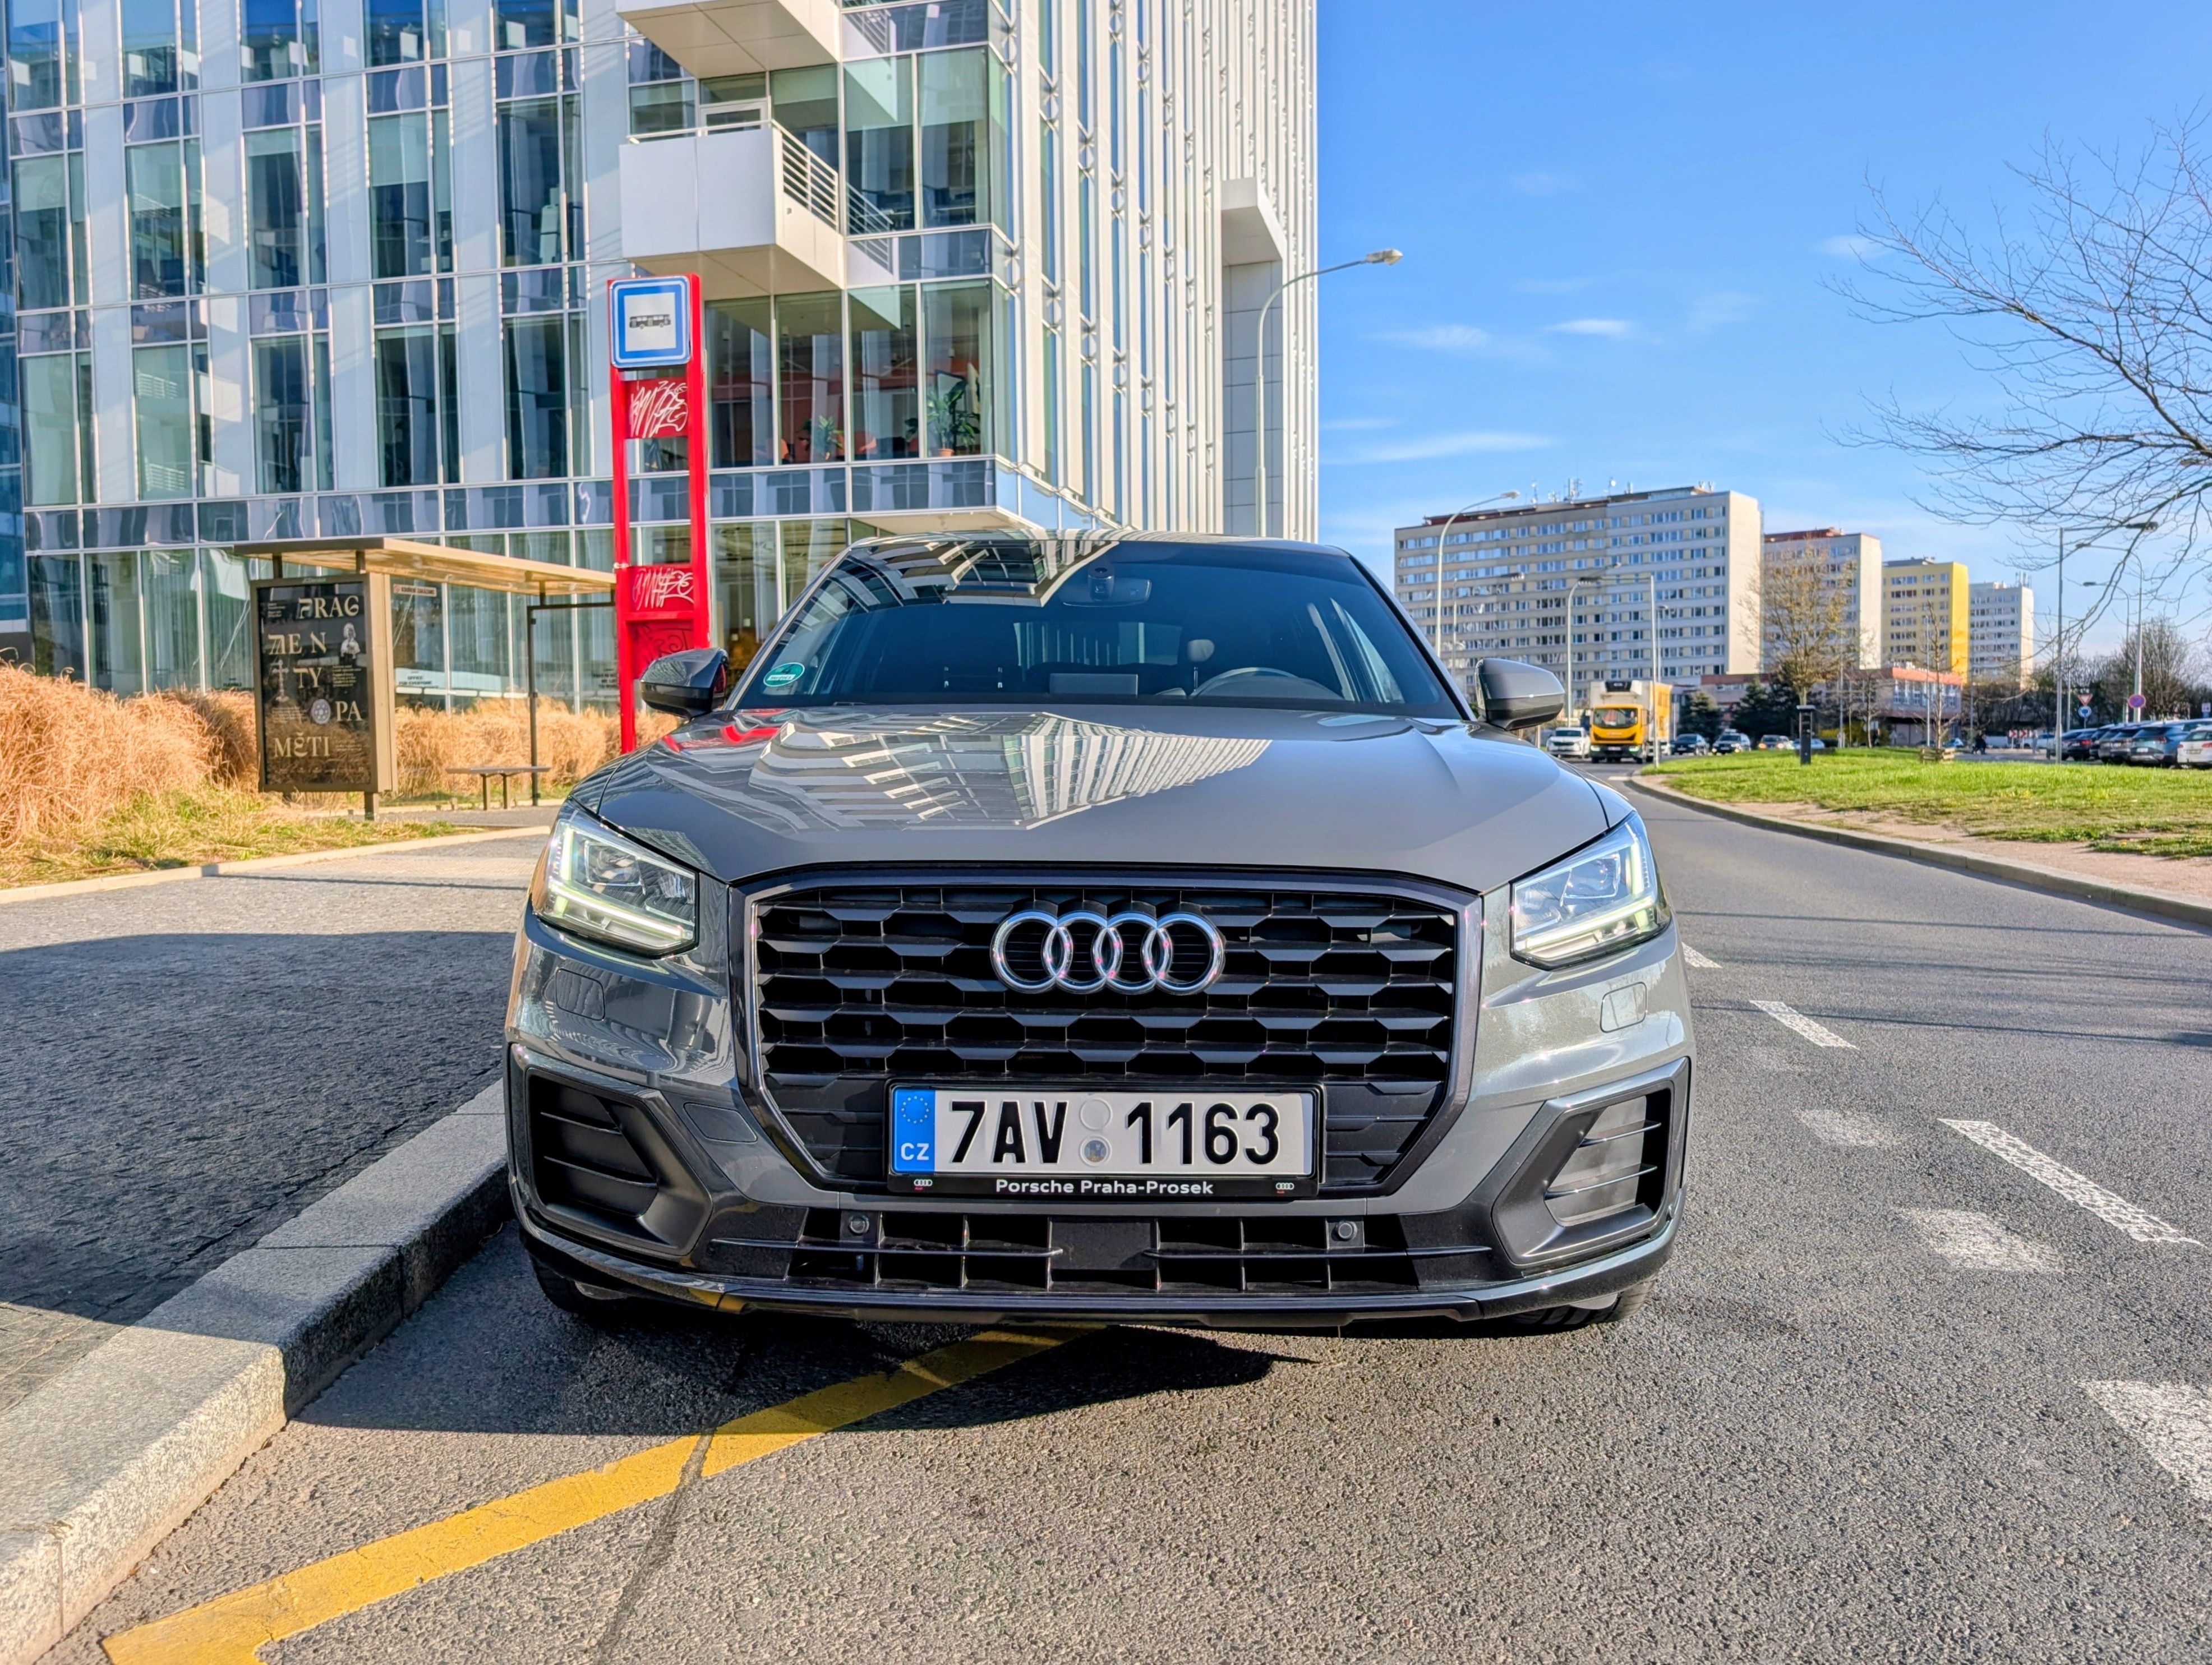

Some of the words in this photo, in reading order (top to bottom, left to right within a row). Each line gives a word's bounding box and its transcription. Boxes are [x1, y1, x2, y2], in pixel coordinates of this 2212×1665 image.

[335, 700, 363, 722] PA
[951, 1101, 1068, 1163] 7AV
[1127, 1101, 1279, 1165] 1163
[900, 1142, 929, 1160] CZ
[996, 1179, 1074, 1193] Porsche
[1080, 1179, 1214, 1194] Praha-Prosek
